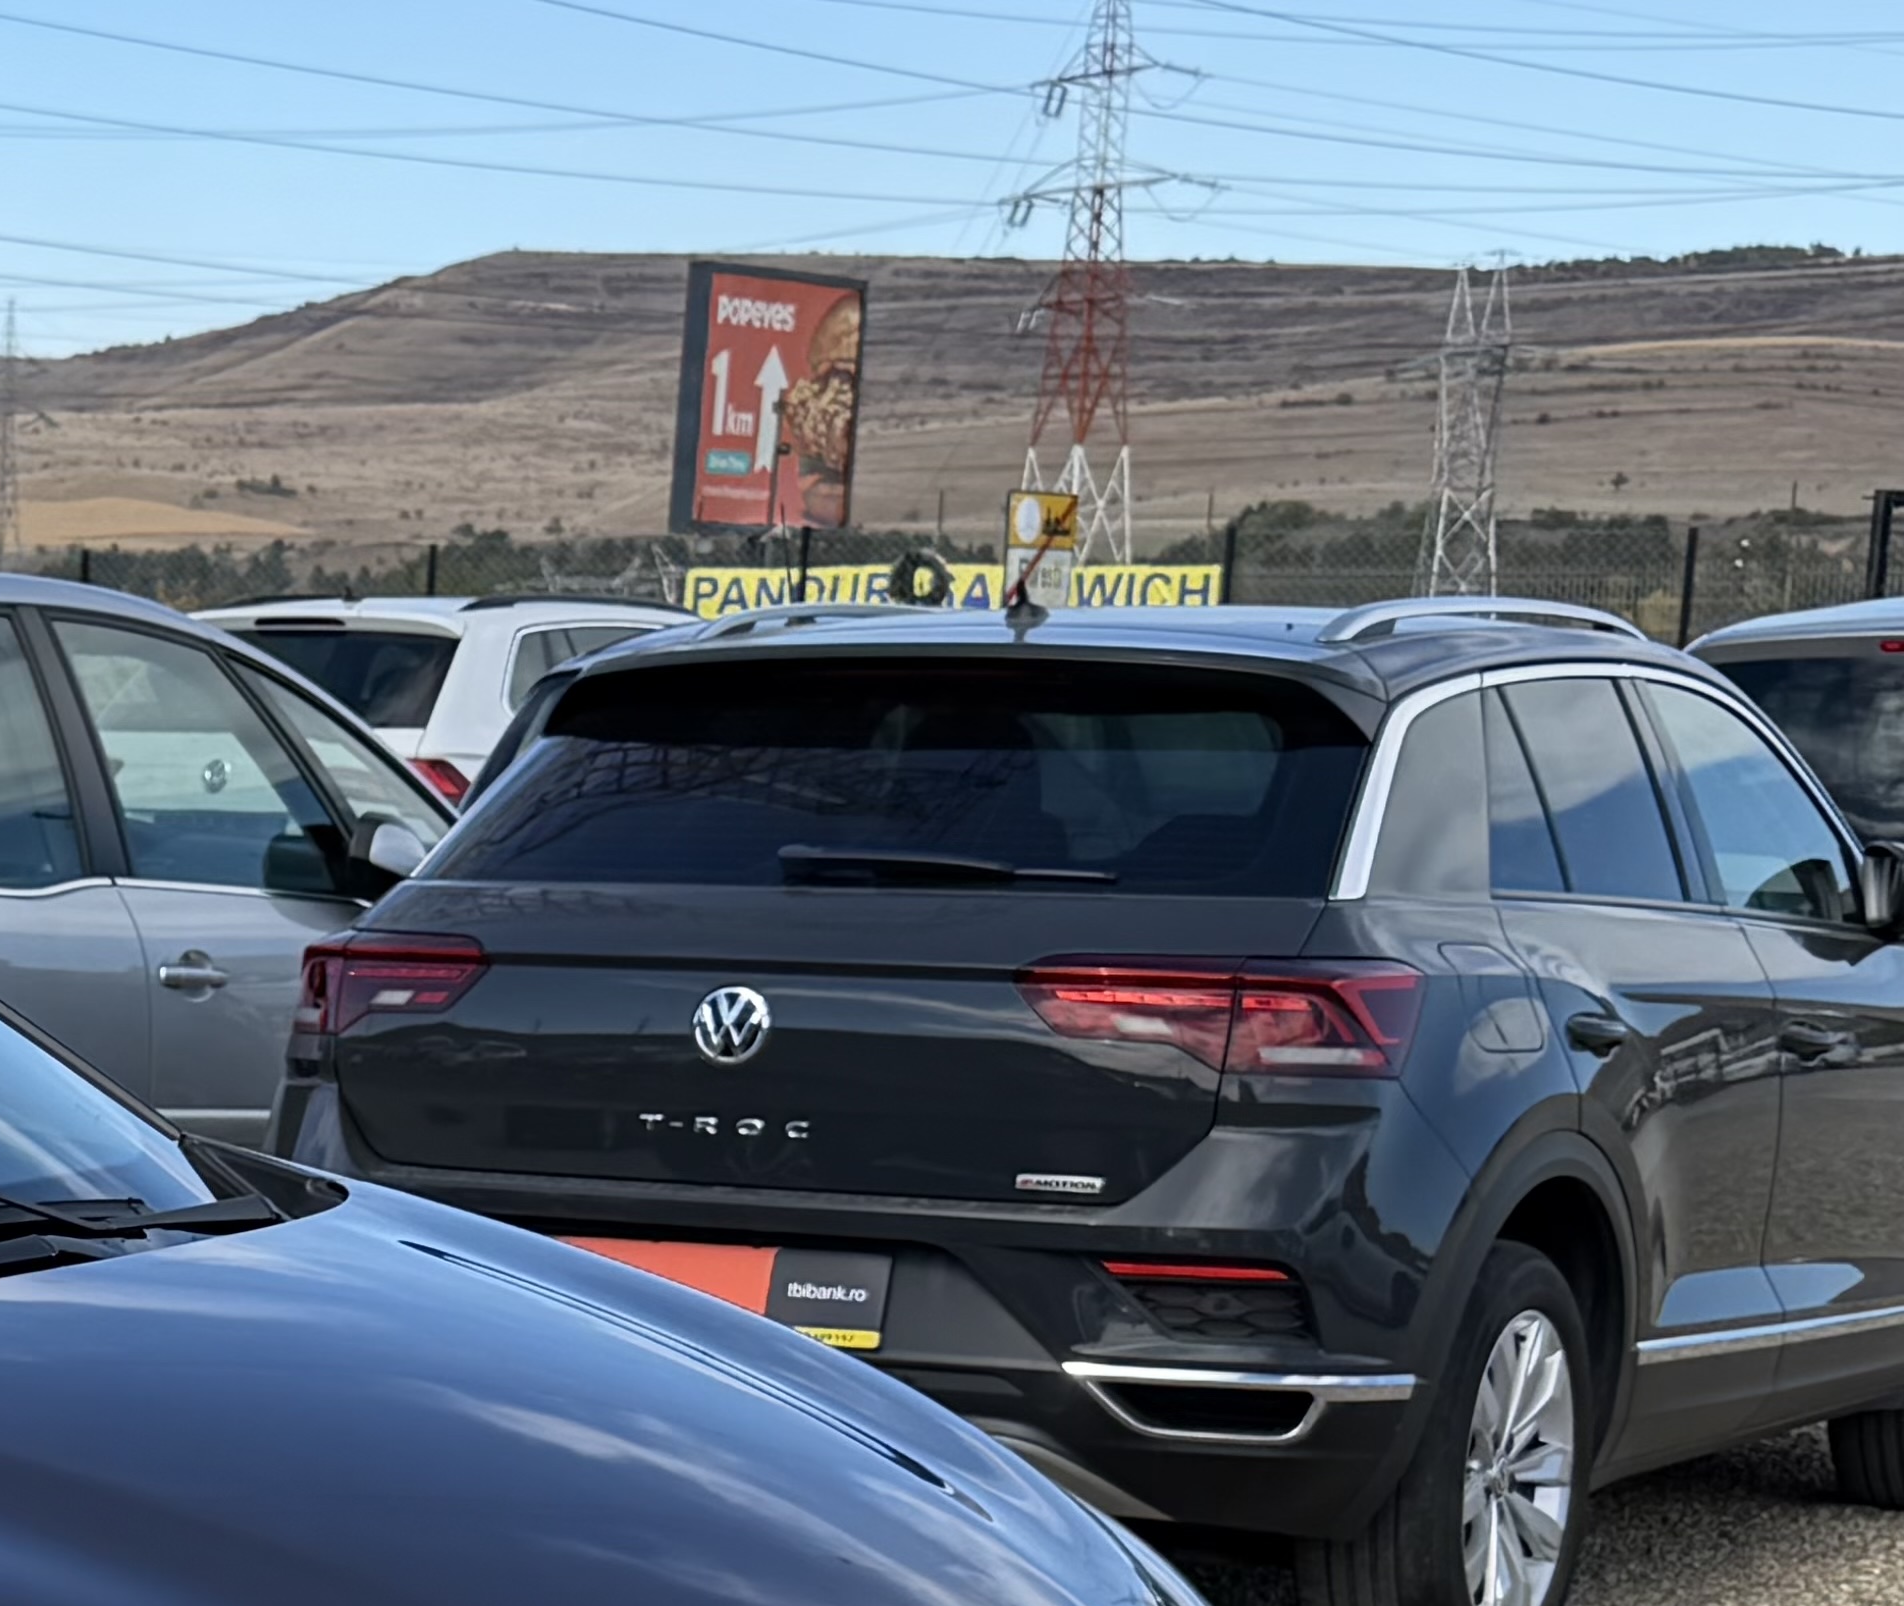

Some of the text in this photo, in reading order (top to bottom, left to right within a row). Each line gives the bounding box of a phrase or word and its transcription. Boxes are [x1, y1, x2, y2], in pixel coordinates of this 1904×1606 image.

[711, 349, 730, 436] 1
[726, 403, 754, 437] km
[787, 1282, 868, 1303] tbibank.ro
